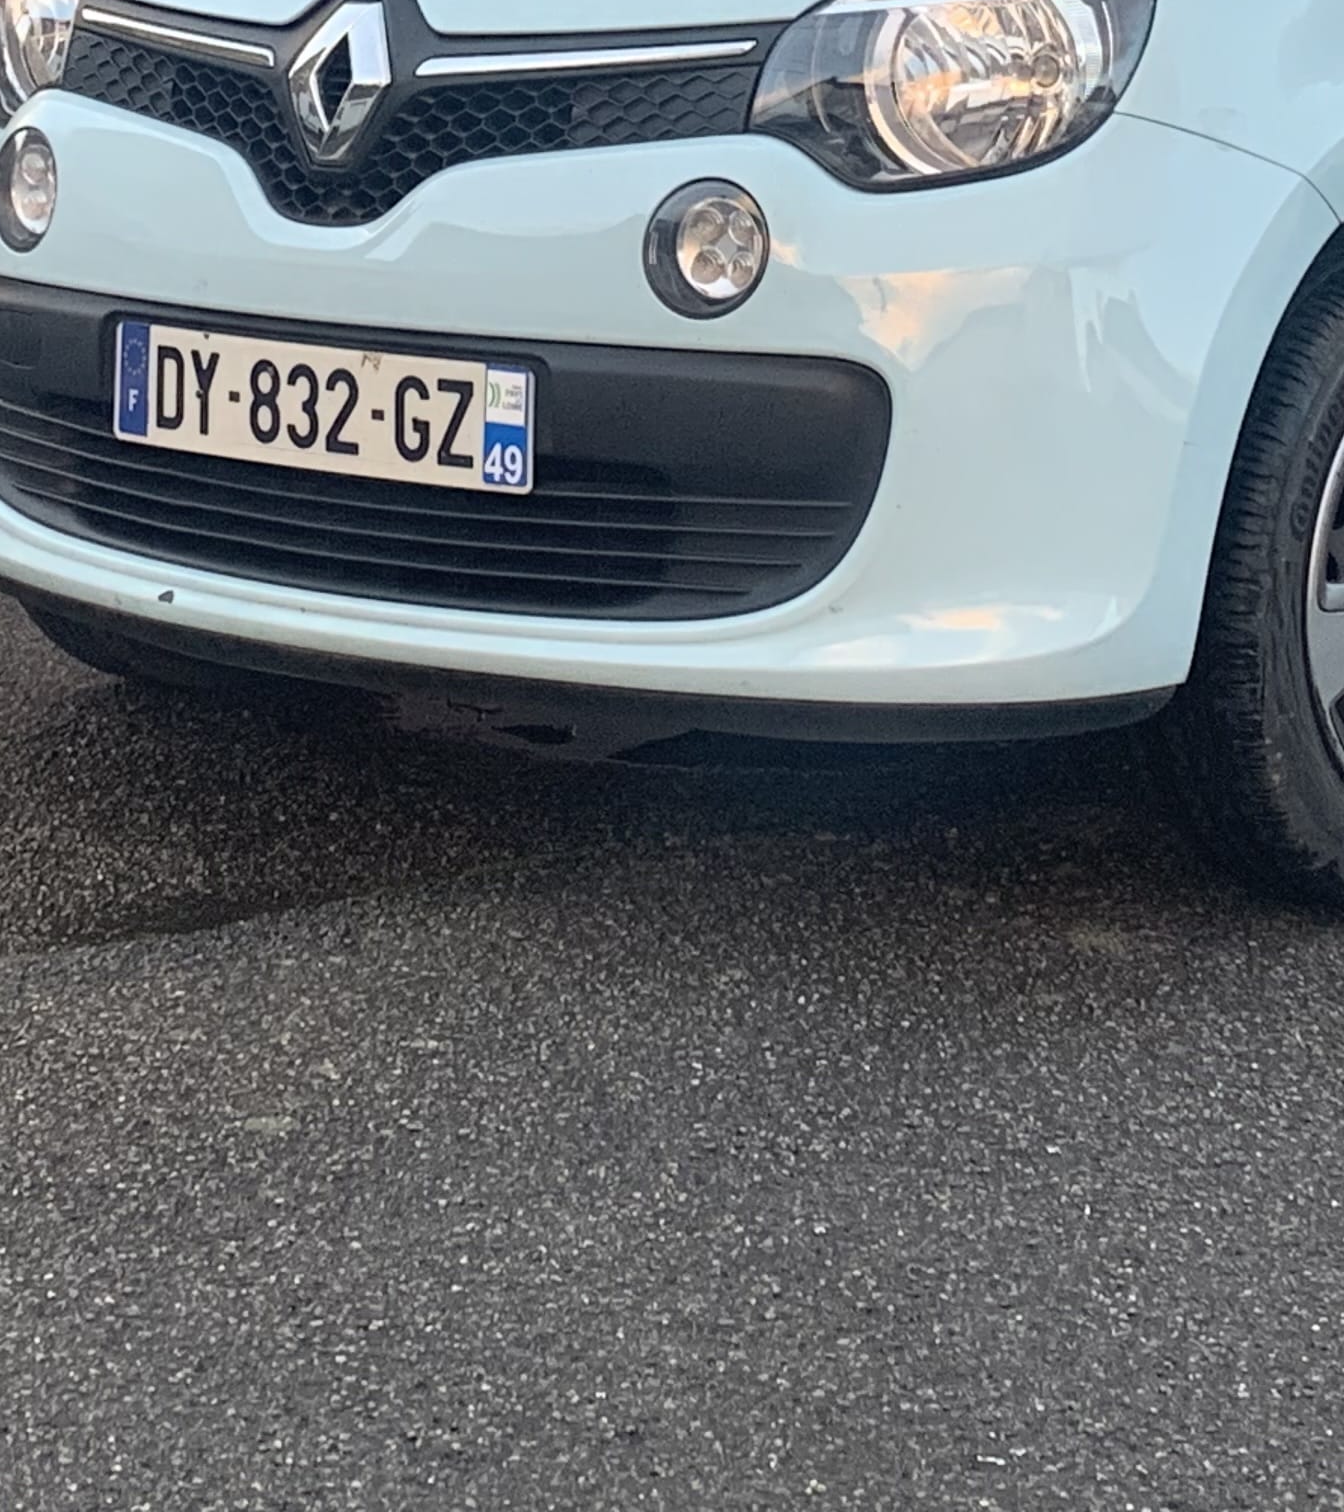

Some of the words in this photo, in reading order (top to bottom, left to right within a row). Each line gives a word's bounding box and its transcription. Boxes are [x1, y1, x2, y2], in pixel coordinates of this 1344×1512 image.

[126, 389, 139, 412] F
[157, 345, 474, 469] DY-832-GZ
[484, 441, 523, 484] 49
